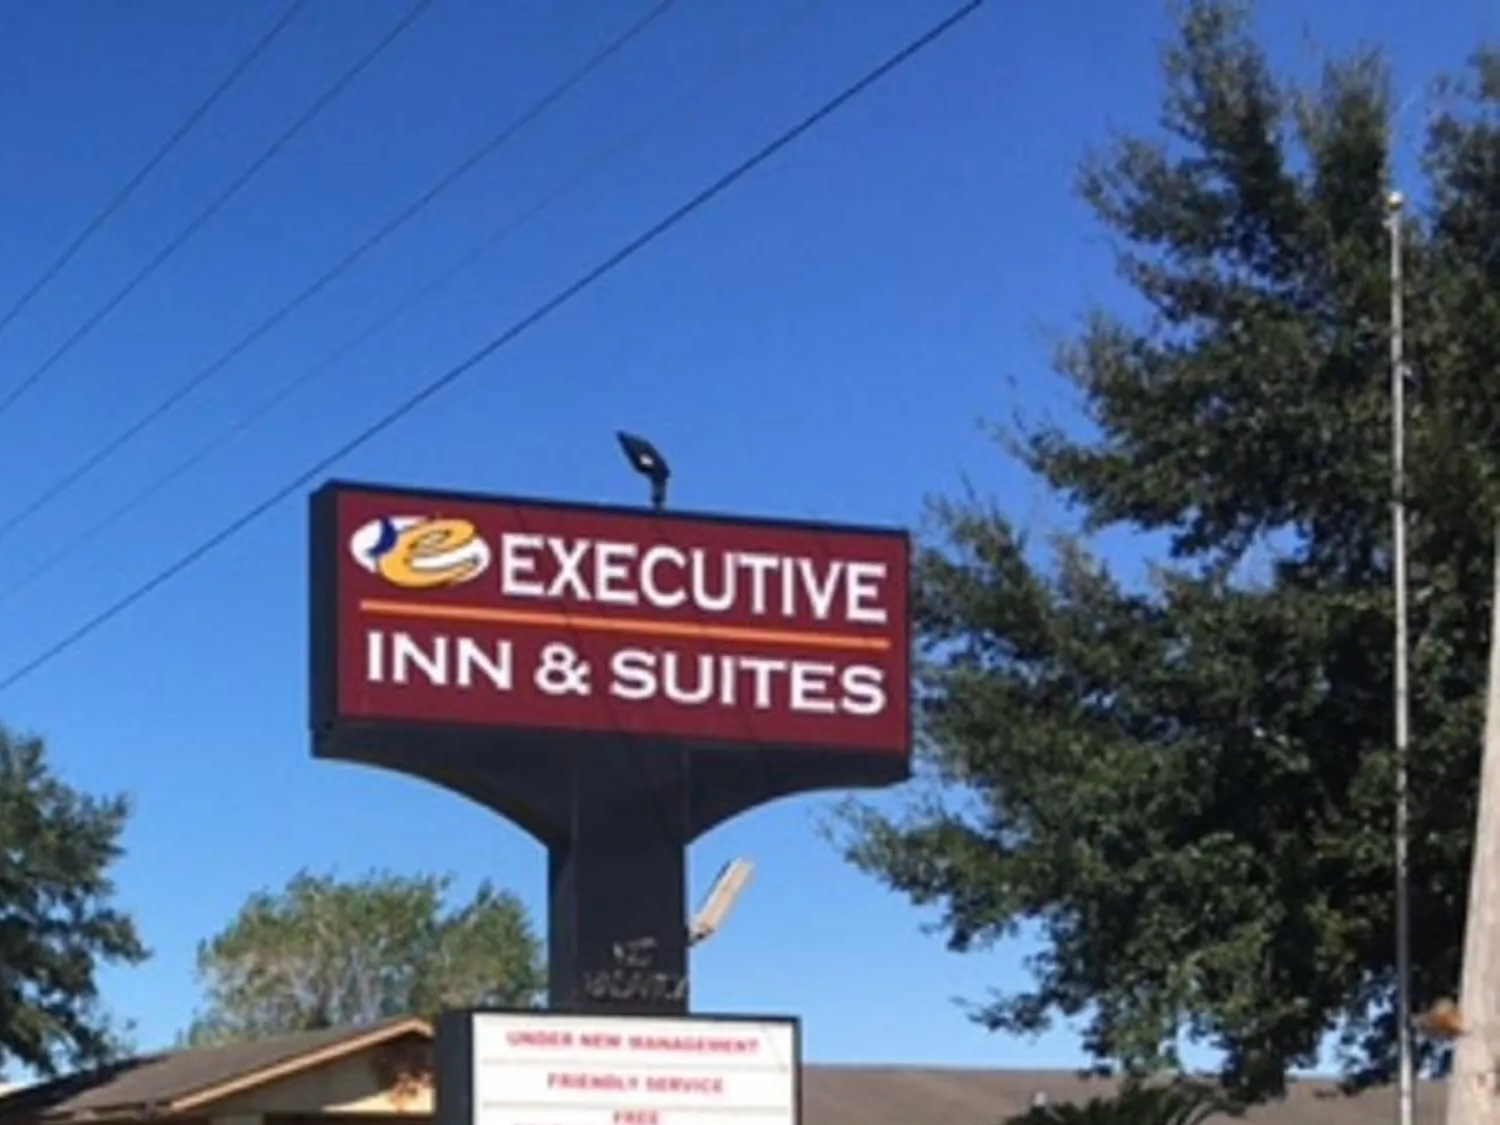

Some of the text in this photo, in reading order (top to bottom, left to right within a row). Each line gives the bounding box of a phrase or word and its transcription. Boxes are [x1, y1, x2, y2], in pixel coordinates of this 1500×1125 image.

[500, 531, 888, 623] EXECUTIVE
[366, 631, 886, 716] INN & SUITES
[506, 1031, 759, 1053] UNDER NEW MANAGEMENT
[548, 1072, 723, 1094] FRIENDLY SERVICE
[613, 1109, 659, 1125] FREE
